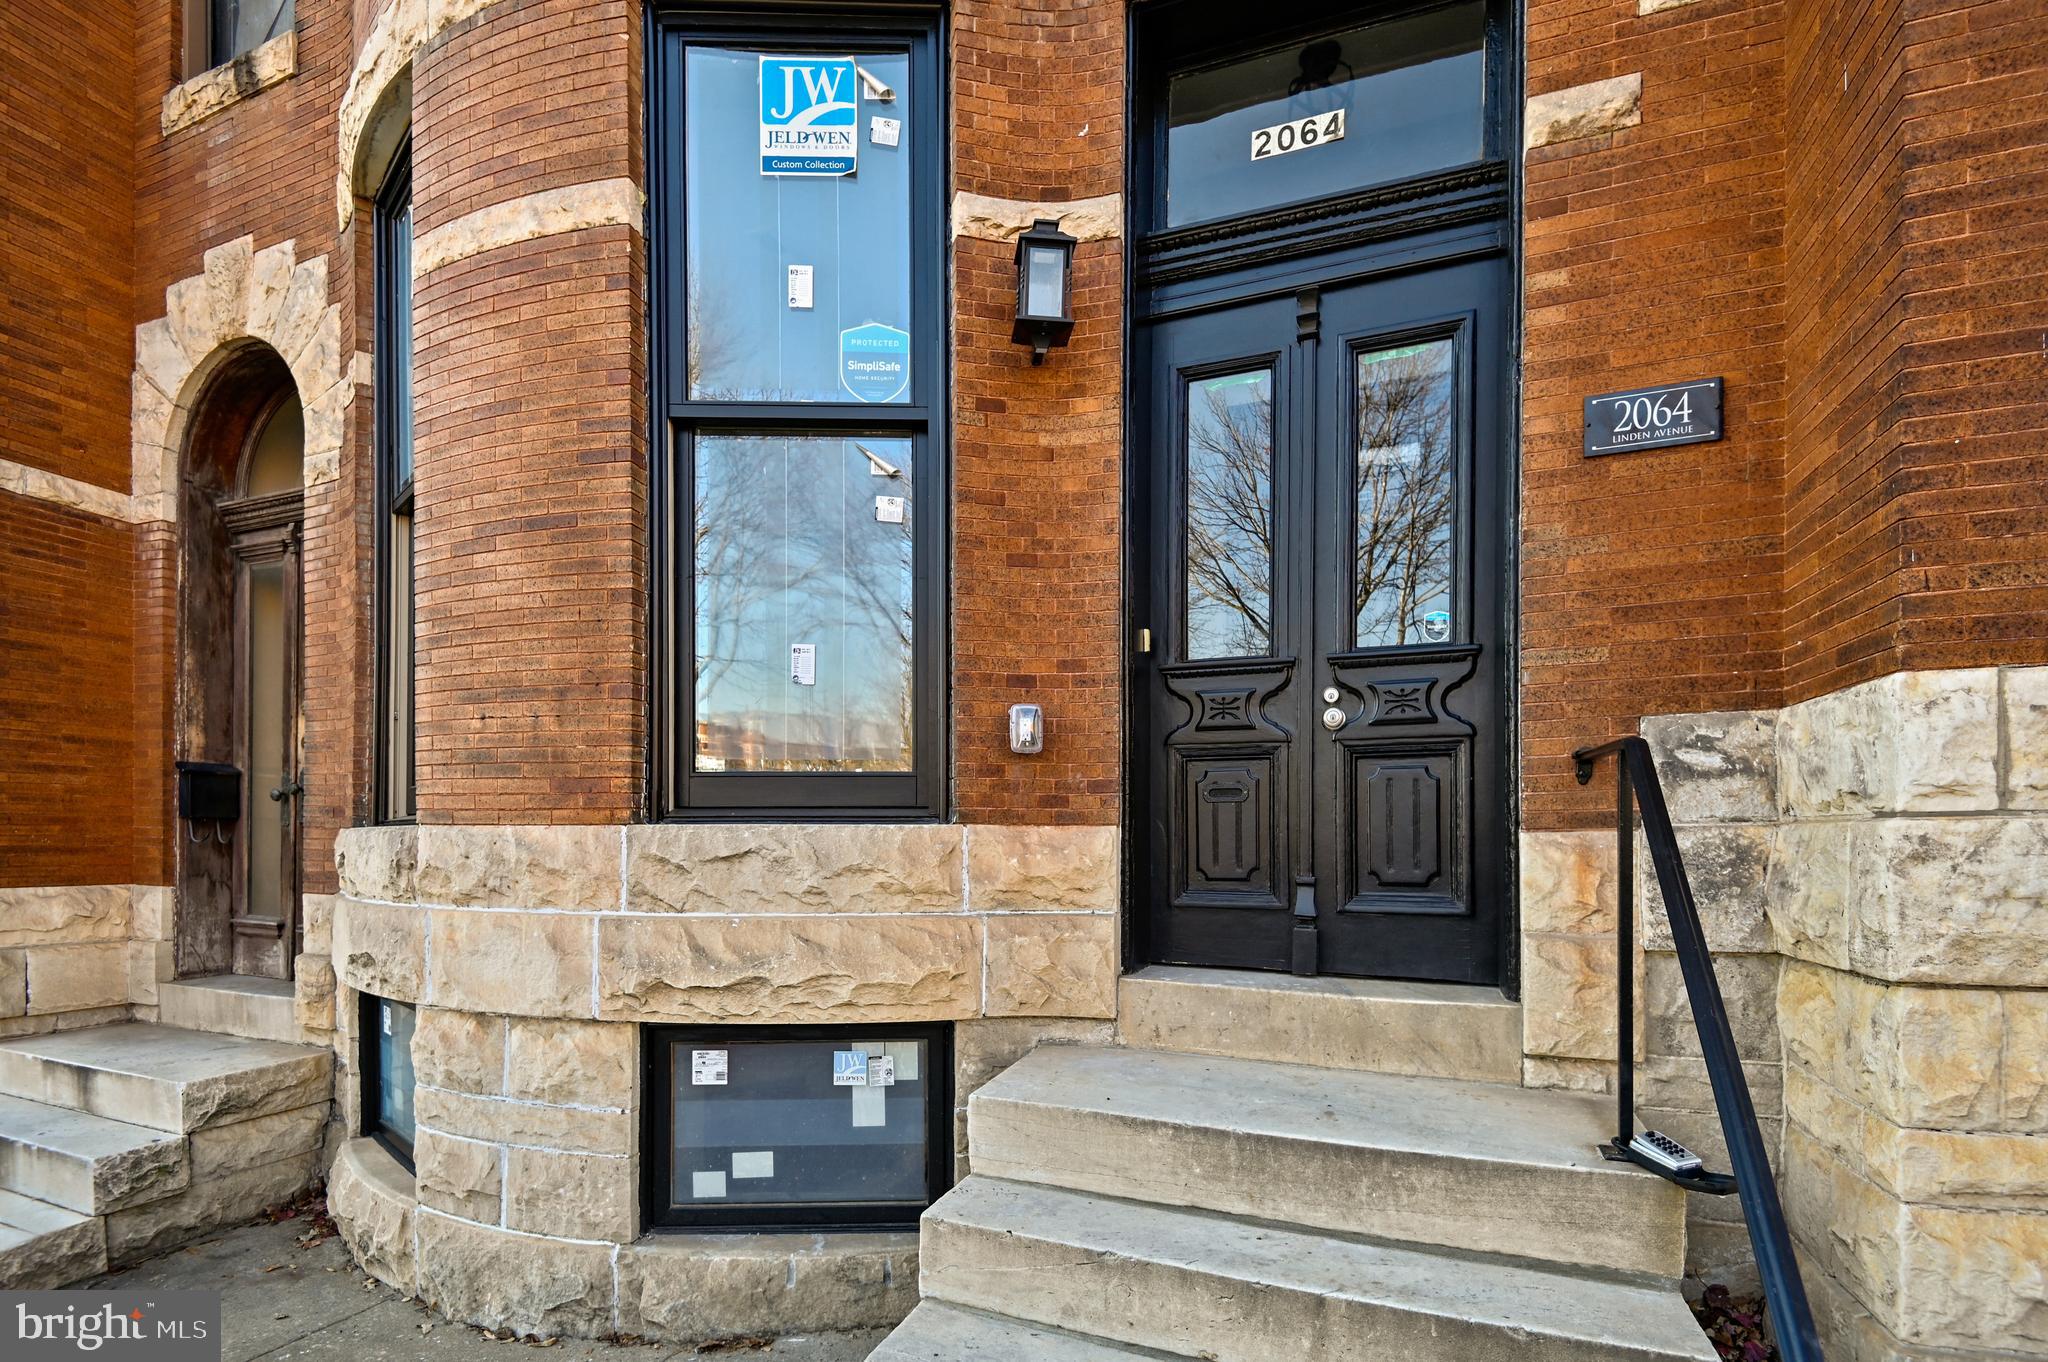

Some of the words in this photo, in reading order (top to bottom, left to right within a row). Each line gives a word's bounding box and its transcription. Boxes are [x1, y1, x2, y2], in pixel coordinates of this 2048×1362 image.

[770, 66, 847, 119] JW
[1254, 112, 1340, 158] 2064
[772, 160, 803, 169] Custom
[804, 160, 845, 169] Collection
[851, 338, 900, 347] PROTECTED
[847, 360, 901, 373] SimpliSafe
[1613, 391, 1693, 433] 2064
[1612, 431, 1651, 444] LINDEN
[1653, 425, 1694, 438] AVENUE
[837, 1053, 864, 1073] JW
